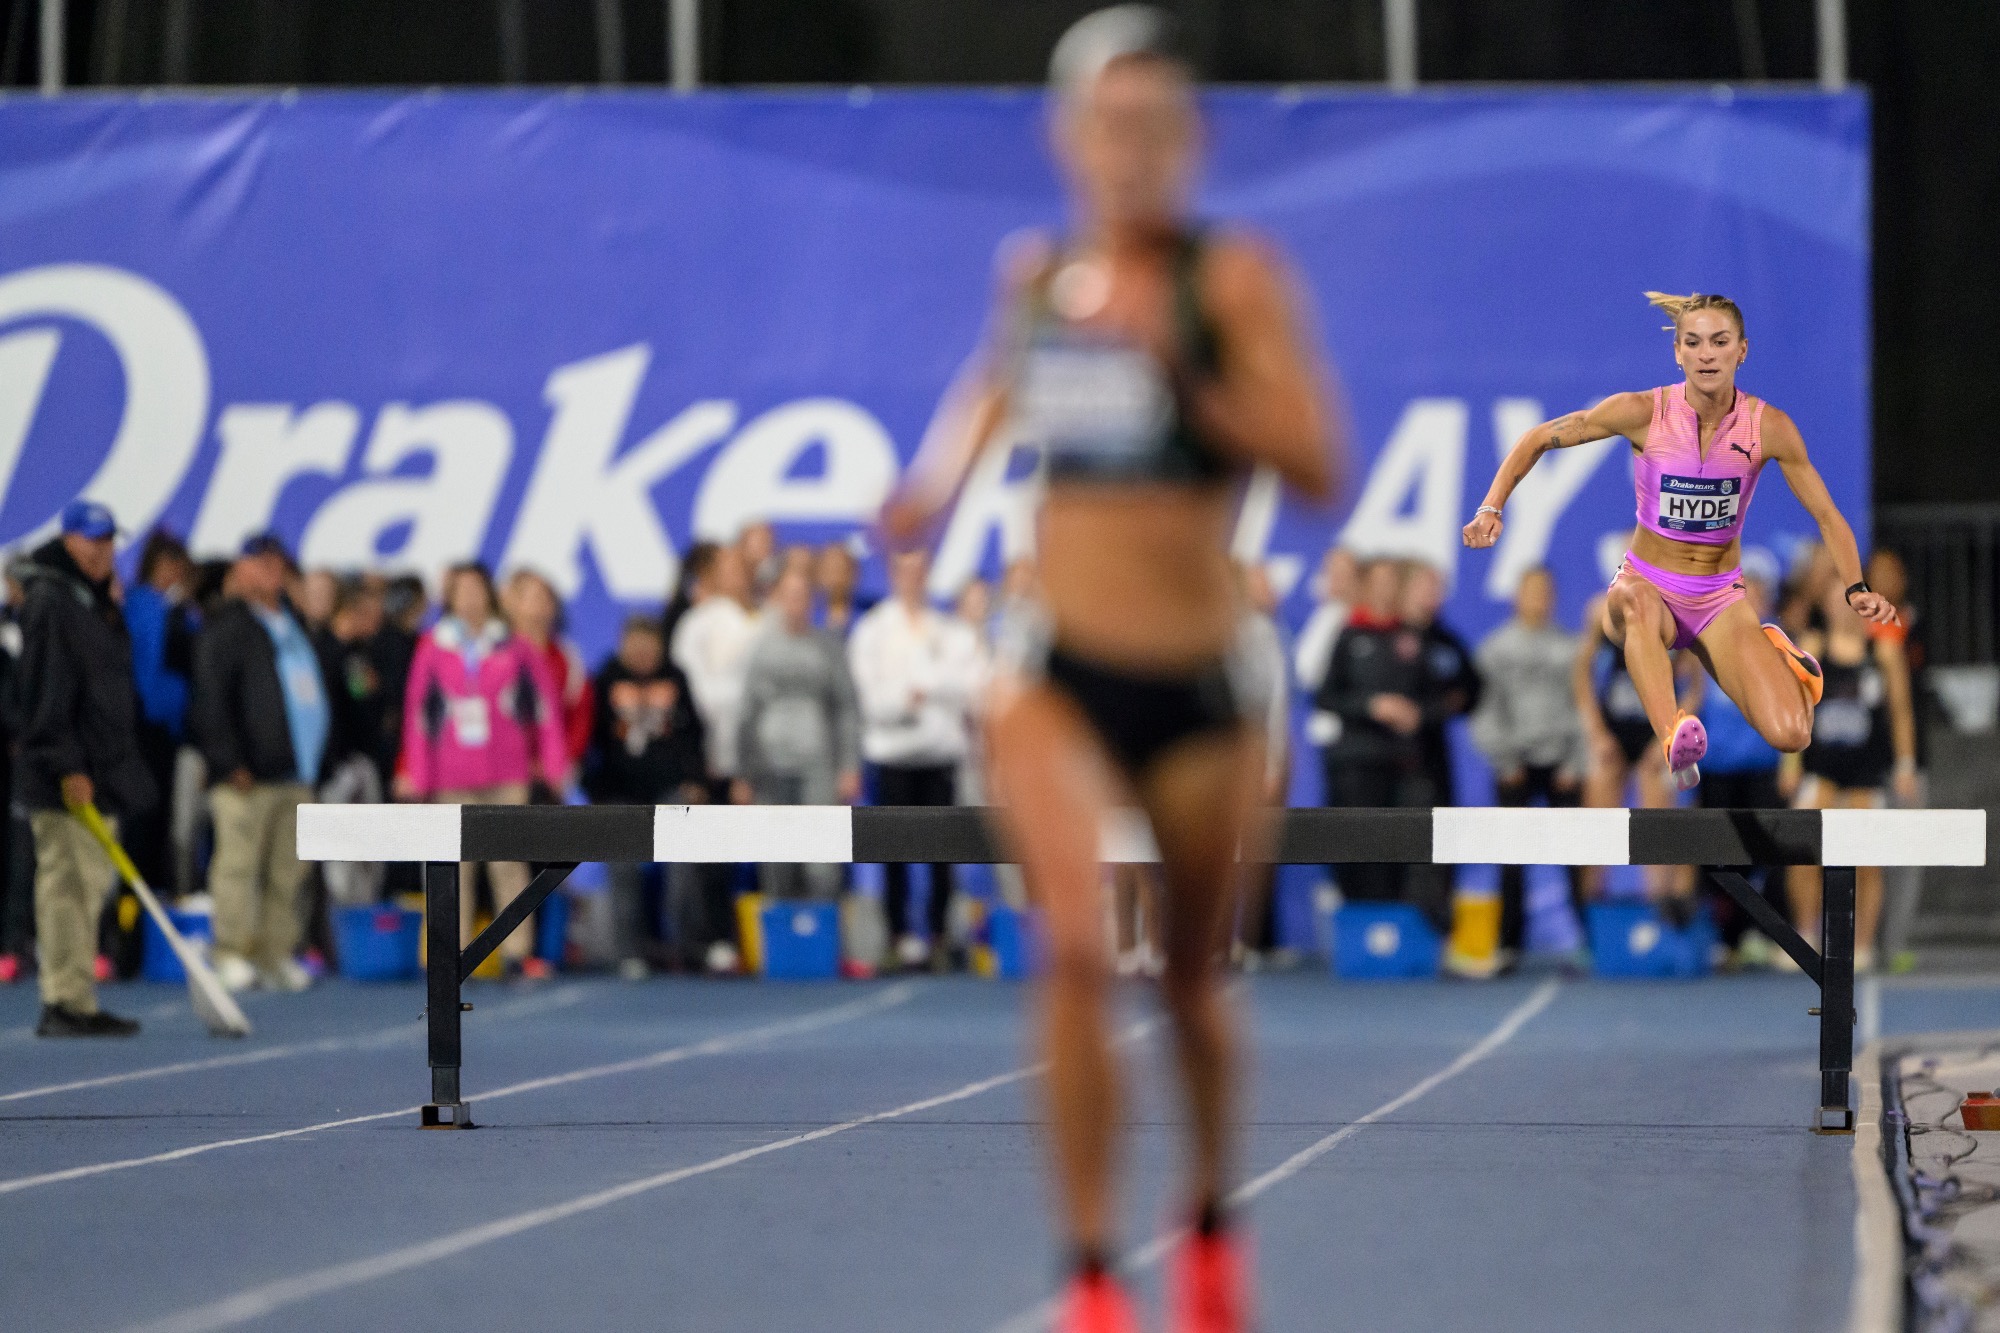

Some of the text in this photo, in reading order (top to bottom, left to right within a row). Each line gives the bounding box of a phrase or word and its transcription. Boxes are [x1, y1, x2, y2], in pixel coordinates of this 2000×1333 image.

[0, 264, 897, 602] Drake
[1669, 479, 1694, 489] Drake
[1669, 497, 1731, 519] HYDE
